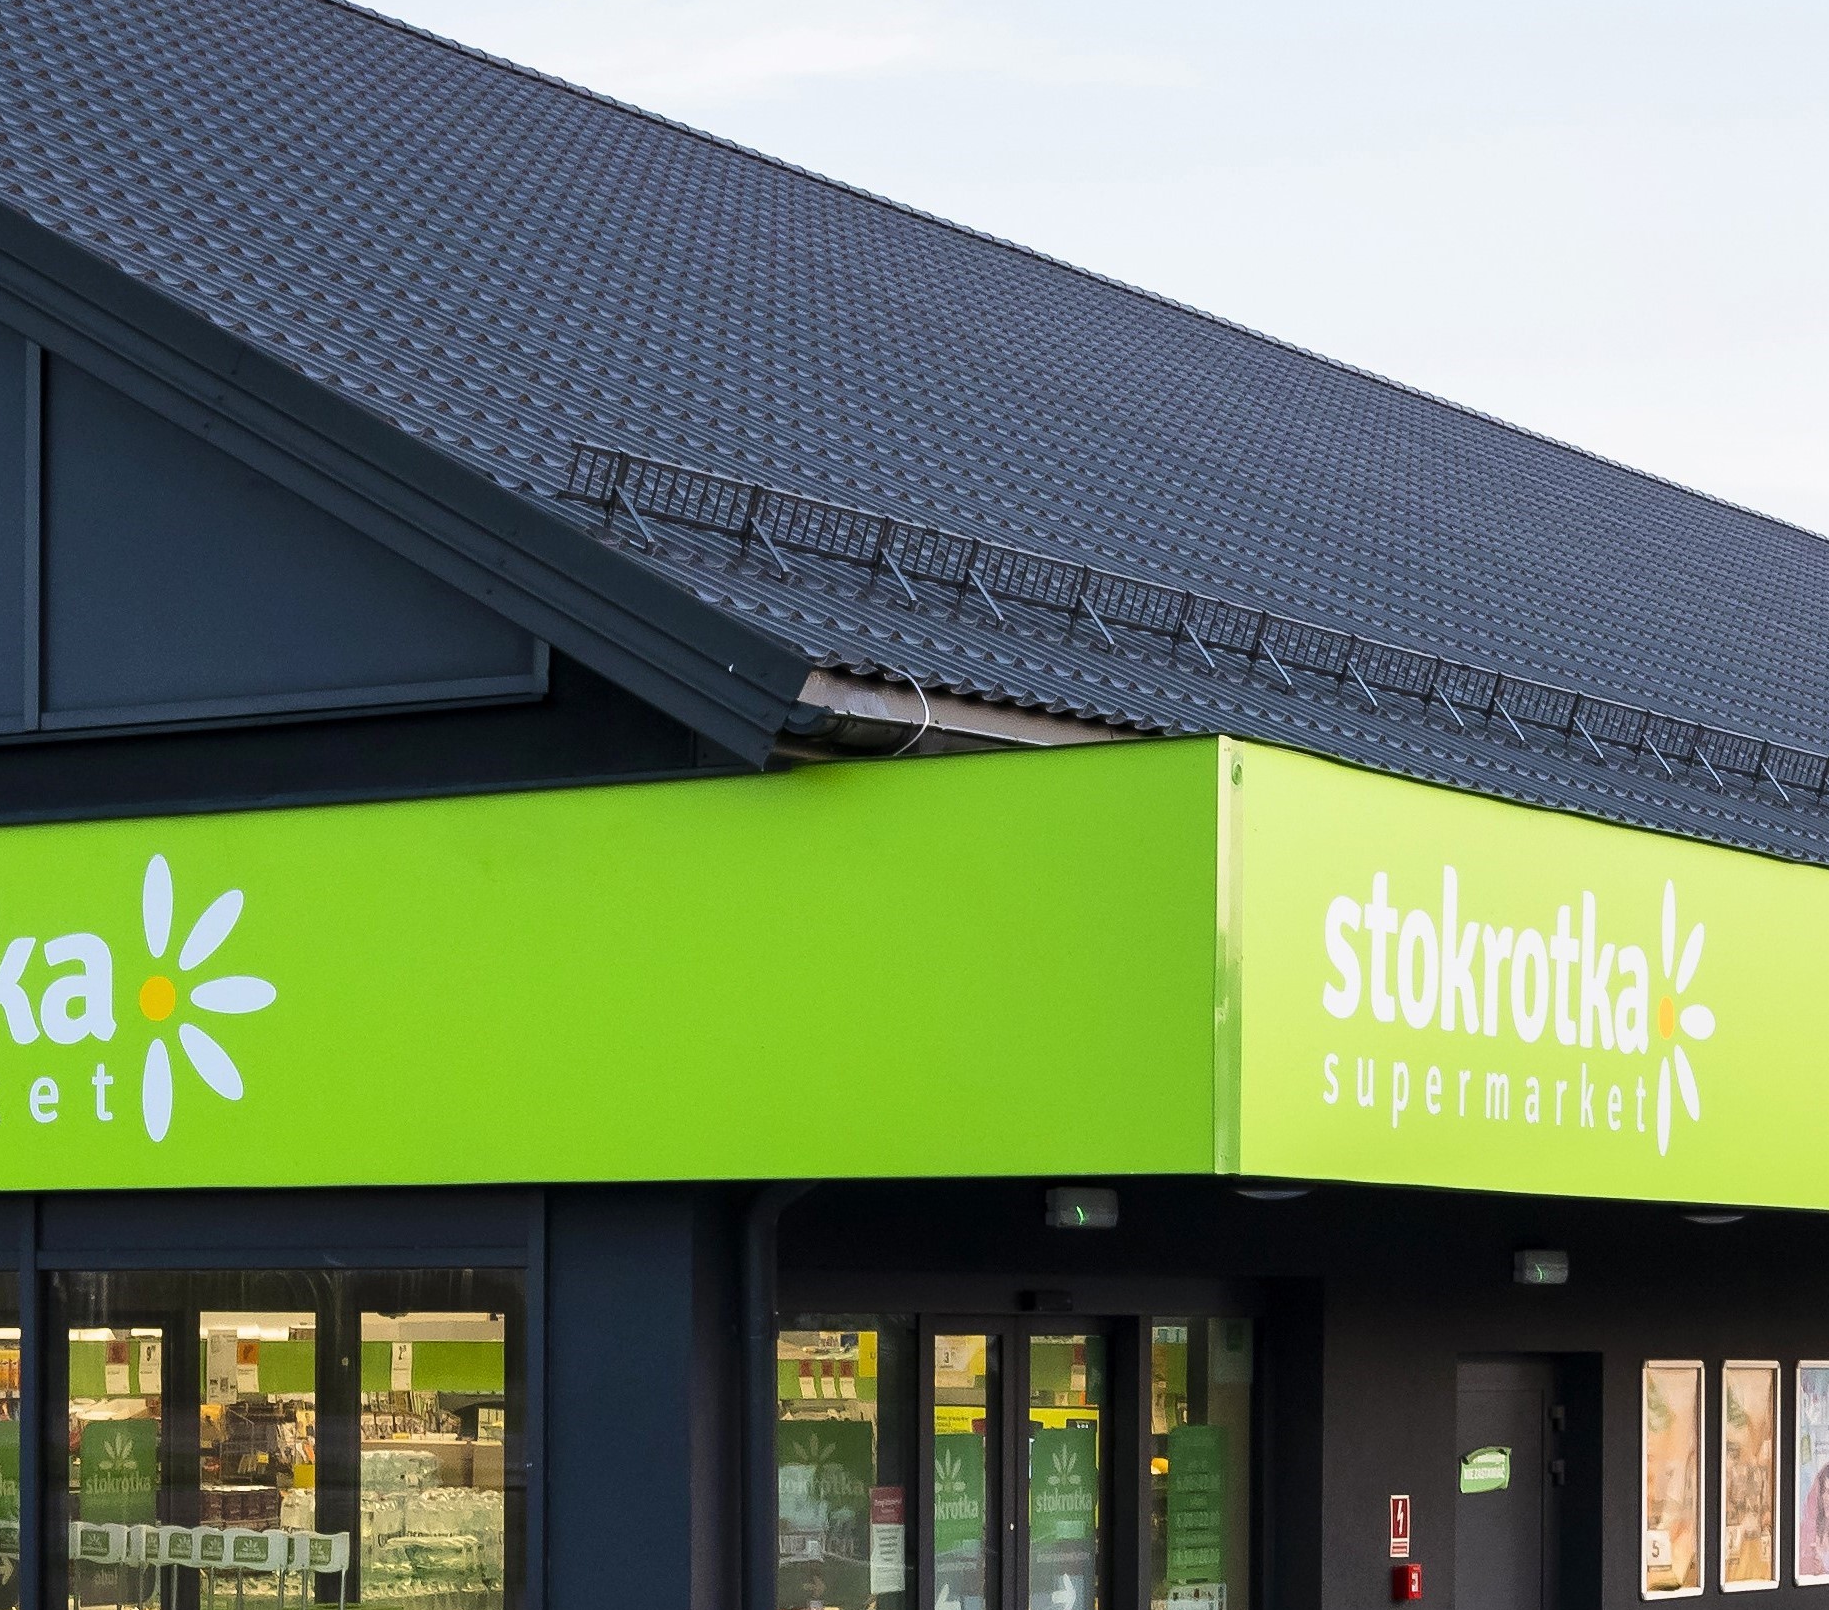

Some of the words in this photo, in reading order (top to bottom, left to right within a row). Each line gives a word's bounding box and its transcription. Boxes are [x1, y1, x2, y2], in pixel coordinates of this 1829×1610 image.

[1322, 864, 1649, 1055] stokrotka
[1322, 1052, 1647, 1133] supermarket
[85, 1468, 151, 1494] stokrotka
[1035, 1488, 1093, 1514] stokrotka
